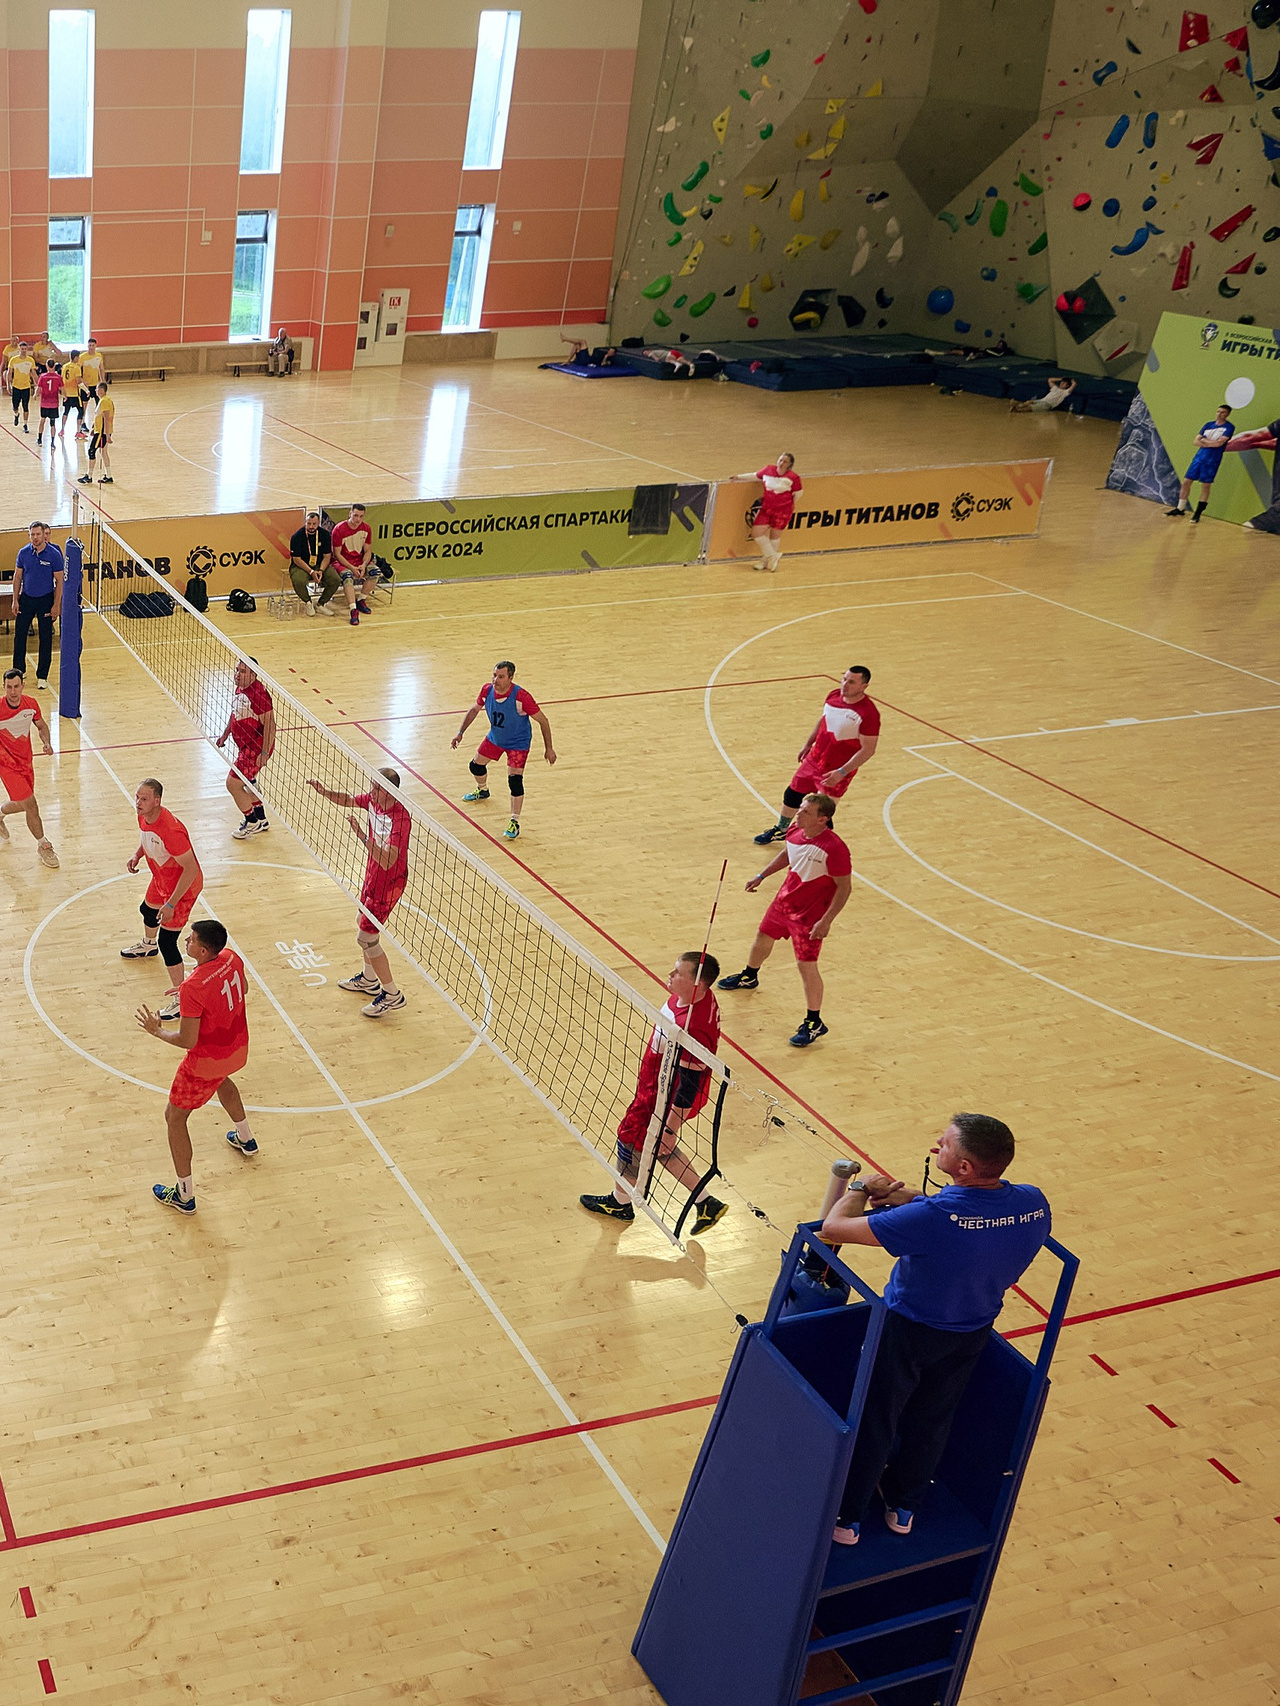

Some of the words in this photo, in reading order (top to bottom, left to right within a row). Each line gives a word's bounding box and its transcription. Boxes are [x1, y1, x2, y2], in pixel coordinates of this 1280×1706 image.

[1221, 340, 1265, 357] ИГРЫ
[46, 379, 53, 391] 1
[845, 502, 940, 525] ТИТАНОВ
[976, 497, 1013, 513] СУЭК
[378, 524, 389, 539] II
[392, 514, 540, 538] ВСЕРОССИЙСКАЯ
[219, 549, 266, 568] СУЭК
[394, 544, 439, 560] СУЭК
[442, 541, 484, 558] 2024
[492, 710, 505, 729] 12
[221, 970, 242, 1012] 11
[959, 1216, 1015, 1230] ЧЕСТНАЯ
[1019, 1208, 1045, 1224] ИГРА
